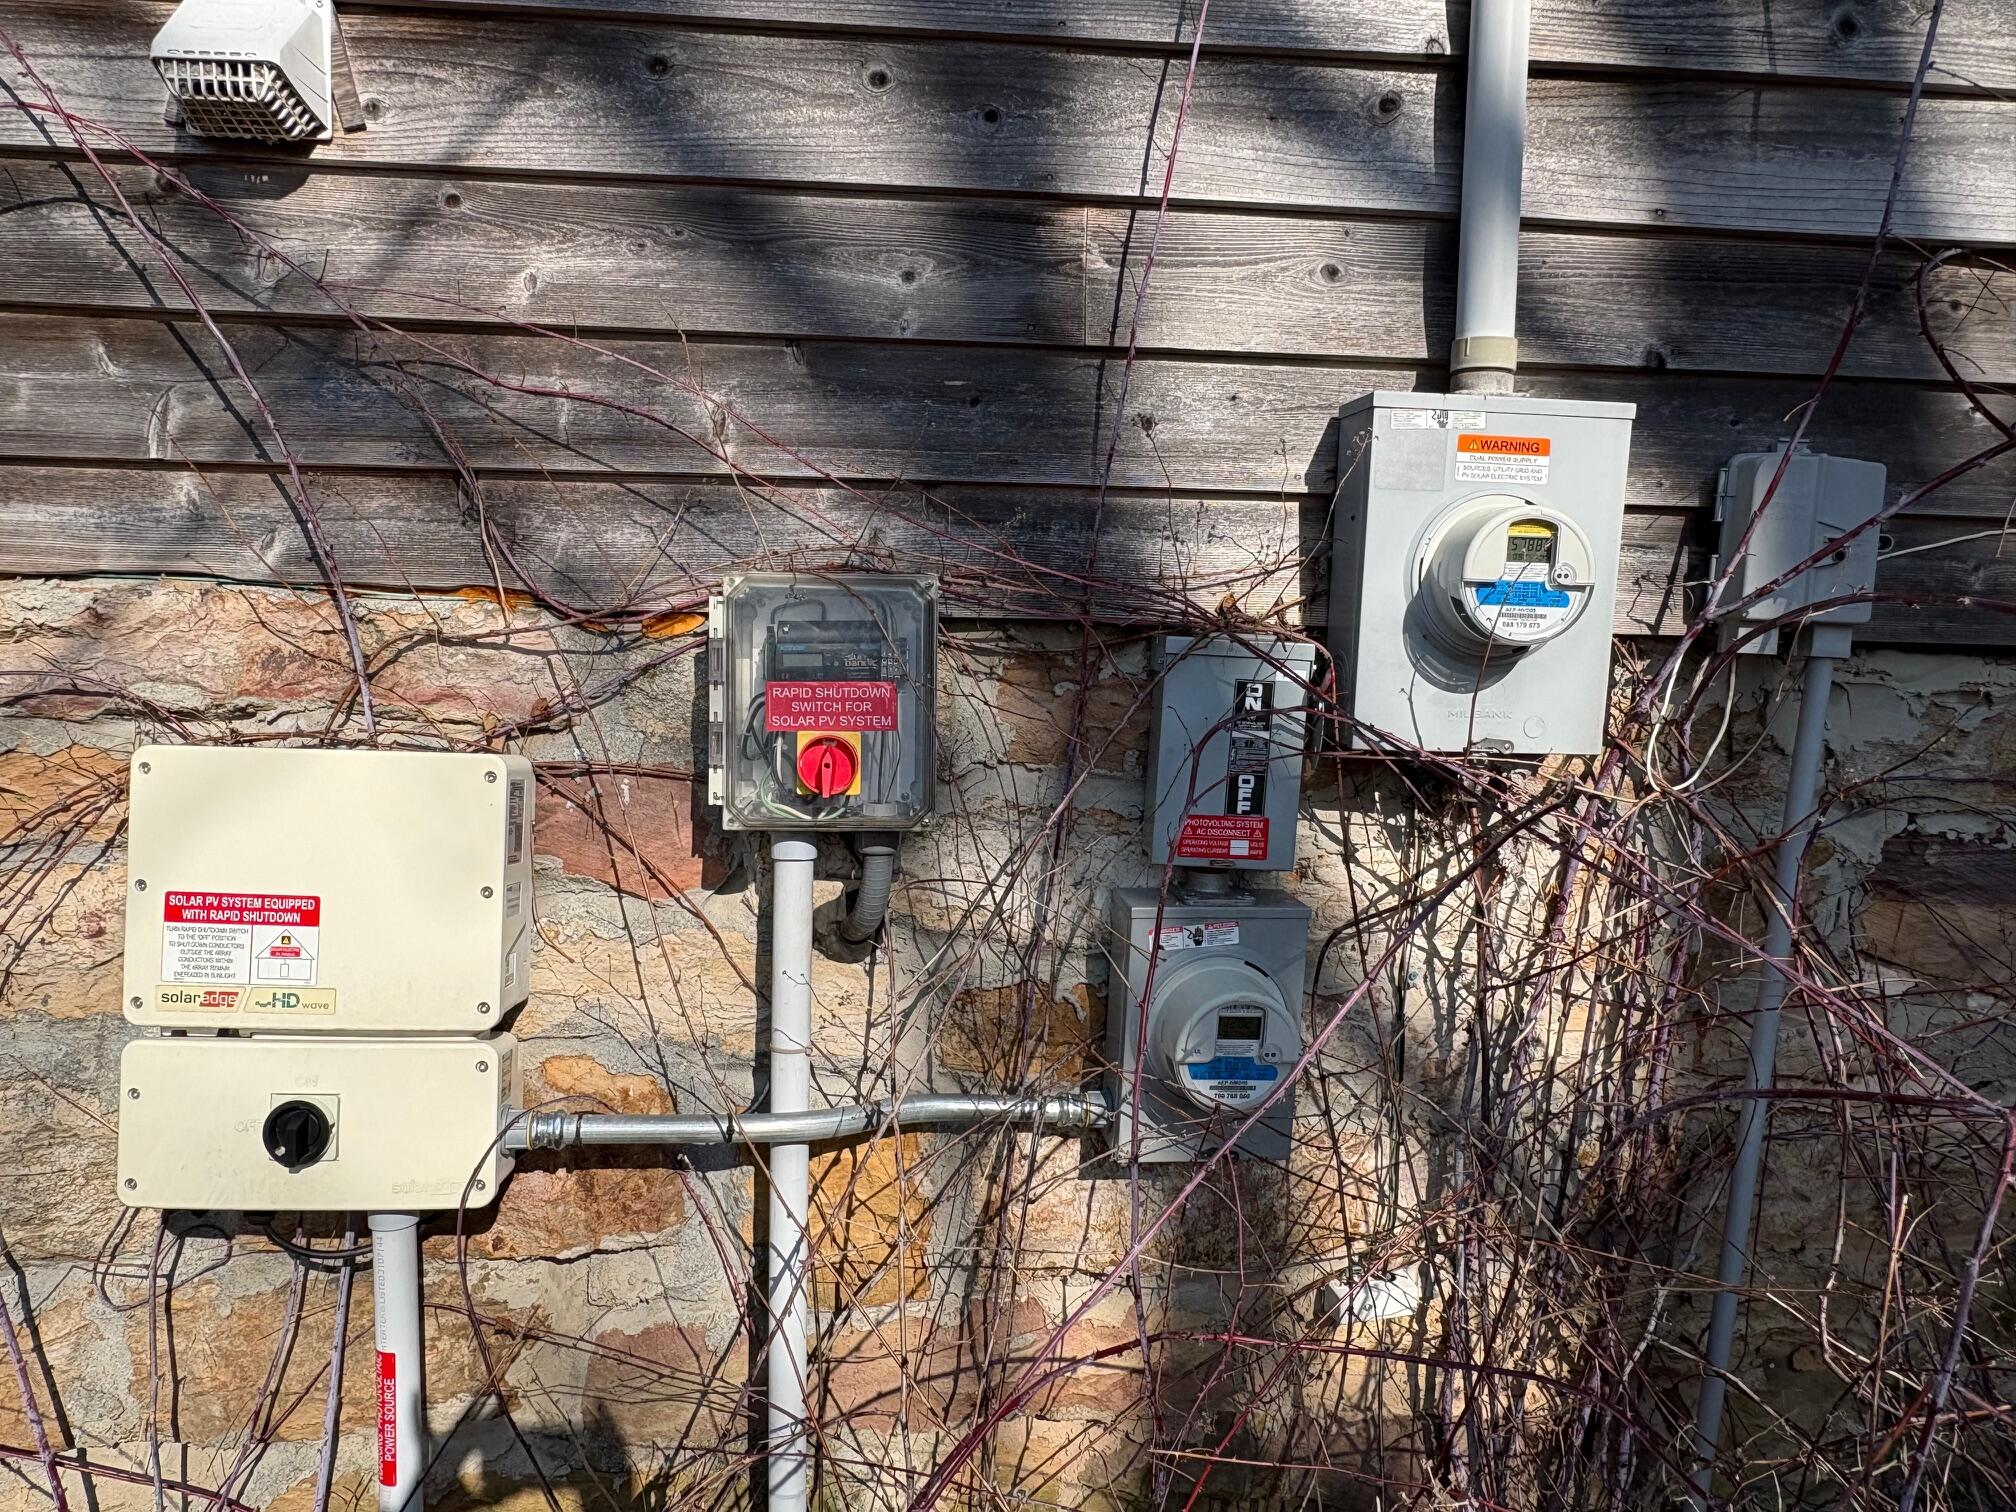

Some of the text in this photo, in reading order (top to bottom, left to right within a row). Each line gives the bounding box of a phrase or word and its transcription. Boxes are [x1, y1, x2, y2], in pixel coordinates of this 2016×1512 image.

[1481, 440, 1540, 452] WARNING
[773, 688, 890, 699] RAPID SHUTDOWN
[1245, 683, 1263, 711] ON
[791, 702, 872, 712] SWITCH FOR
[772, 715, 892, 726] SOLAR PV SYSTEM
[1237, 775, 1255, 814] OFF
[1236, 821, 1263, 829] SYSTEM
[169, 895, 315, 910] SOLAR PV SYSTEM EQUIPPED
[182, 909, 301, 923] WITH RAPID SHUTDOWN
[161, 990, 236, 1007] solaredge
[384, 1378, 395, 1462] POWER SOURCE
